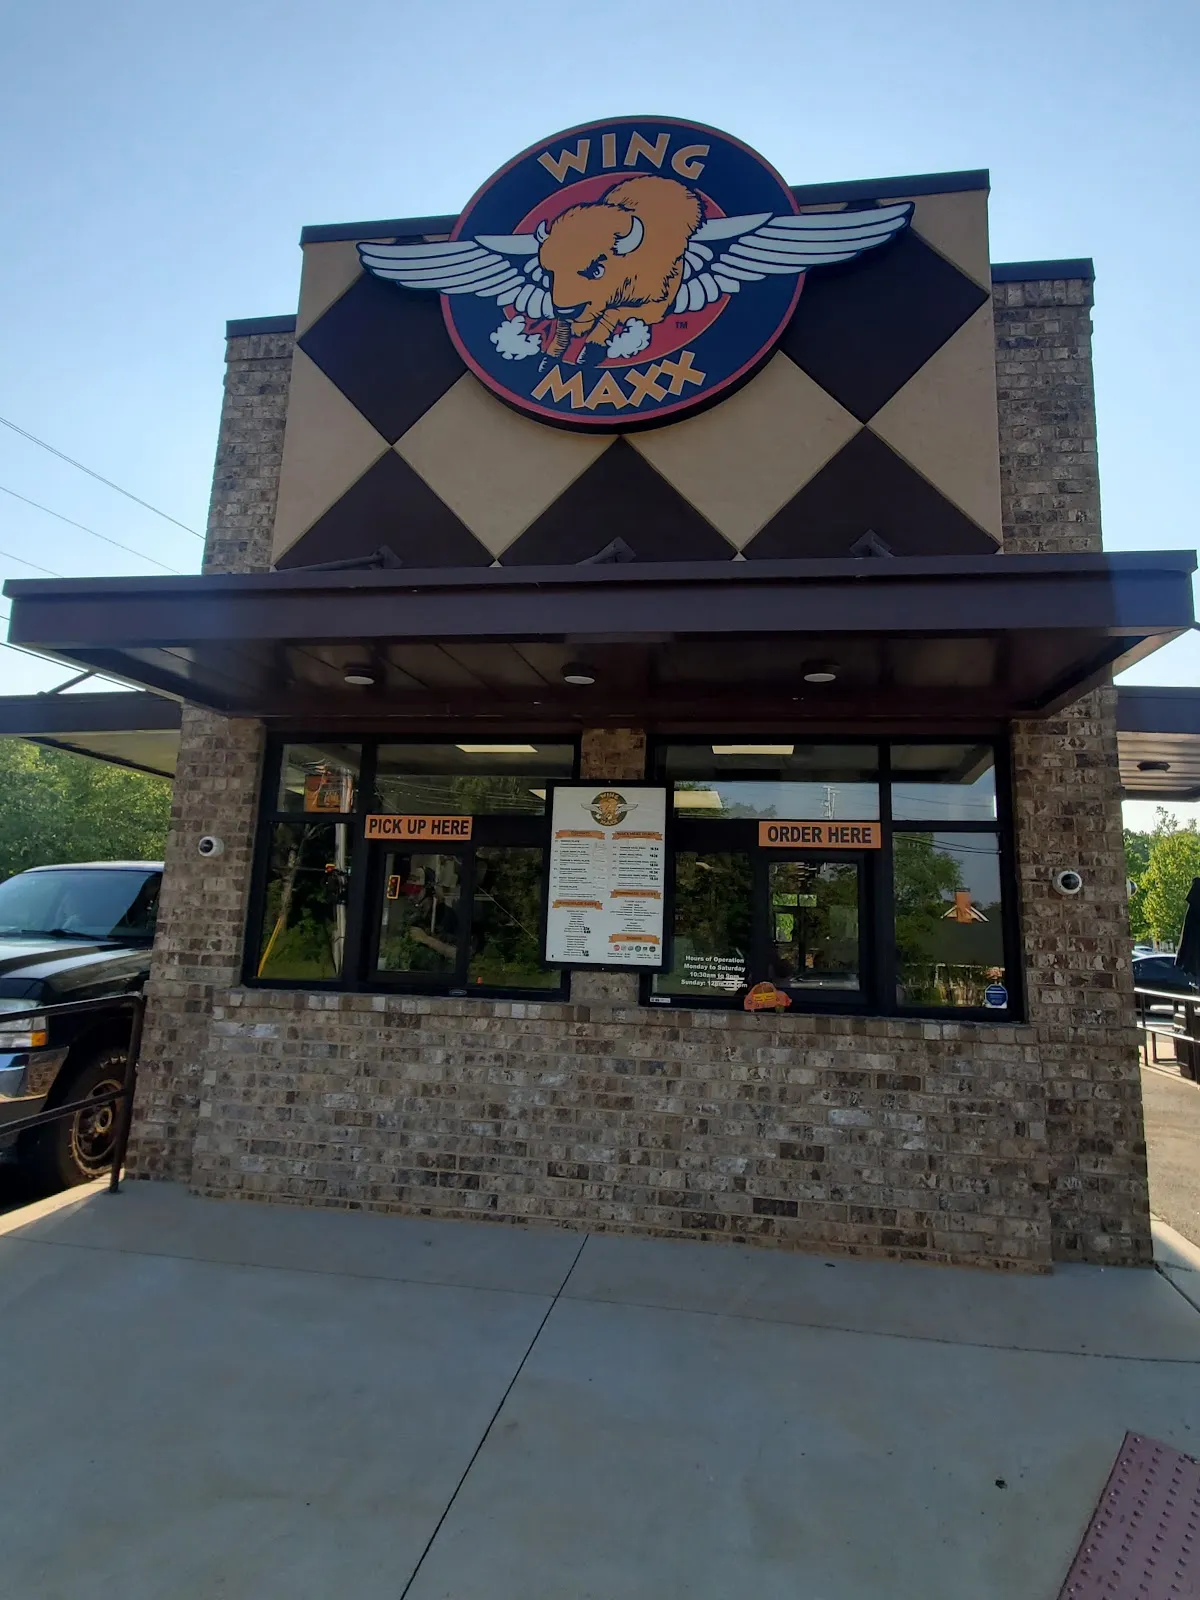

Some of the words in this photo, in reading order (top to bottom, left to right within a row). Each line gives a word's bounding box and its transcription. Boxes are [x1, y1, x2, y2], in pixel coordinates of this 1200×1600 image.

[537, 130, 710, 184] WING
[675, 321, 688, 329] TM
[531, 350, 707, 410] MAXX
[368, 818, 402, 834] PICK
[407, 819, 426, 834] UP
[430, 820, 470, 834] HERE
[767, 826, 822, 842] ORDER
[828, 826, 872, 844] HERE
[718, 964, 746, 972] Saturday
